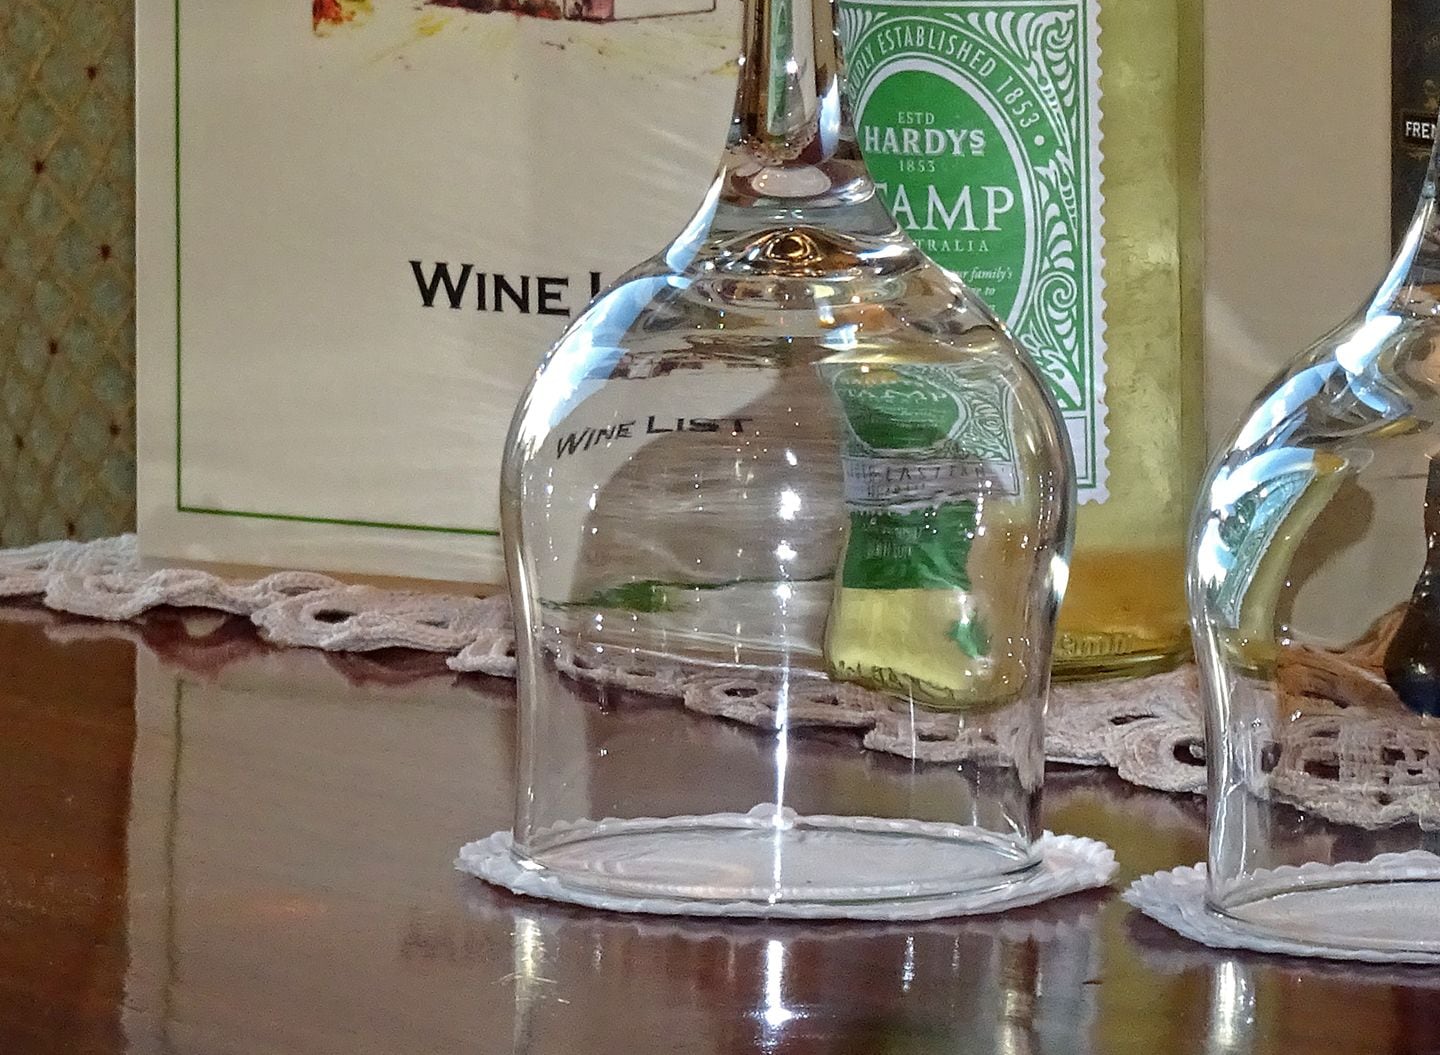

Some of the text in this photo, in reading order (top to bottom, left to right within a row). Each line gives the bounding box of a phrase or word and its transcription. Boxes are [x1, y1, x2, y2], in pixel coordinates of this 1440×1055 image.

[877, 25, 997, 77] ESTABLISHED
[996, 75, 1041, 129] 1853
[898, 111, 935, 125] ESTD
[864, 125, 986, 157] HARDYS
[899, 159, 936, 173] 1853
[875, 182, 1015, 232] AMP
[409, 260, 571, 317] WINE
